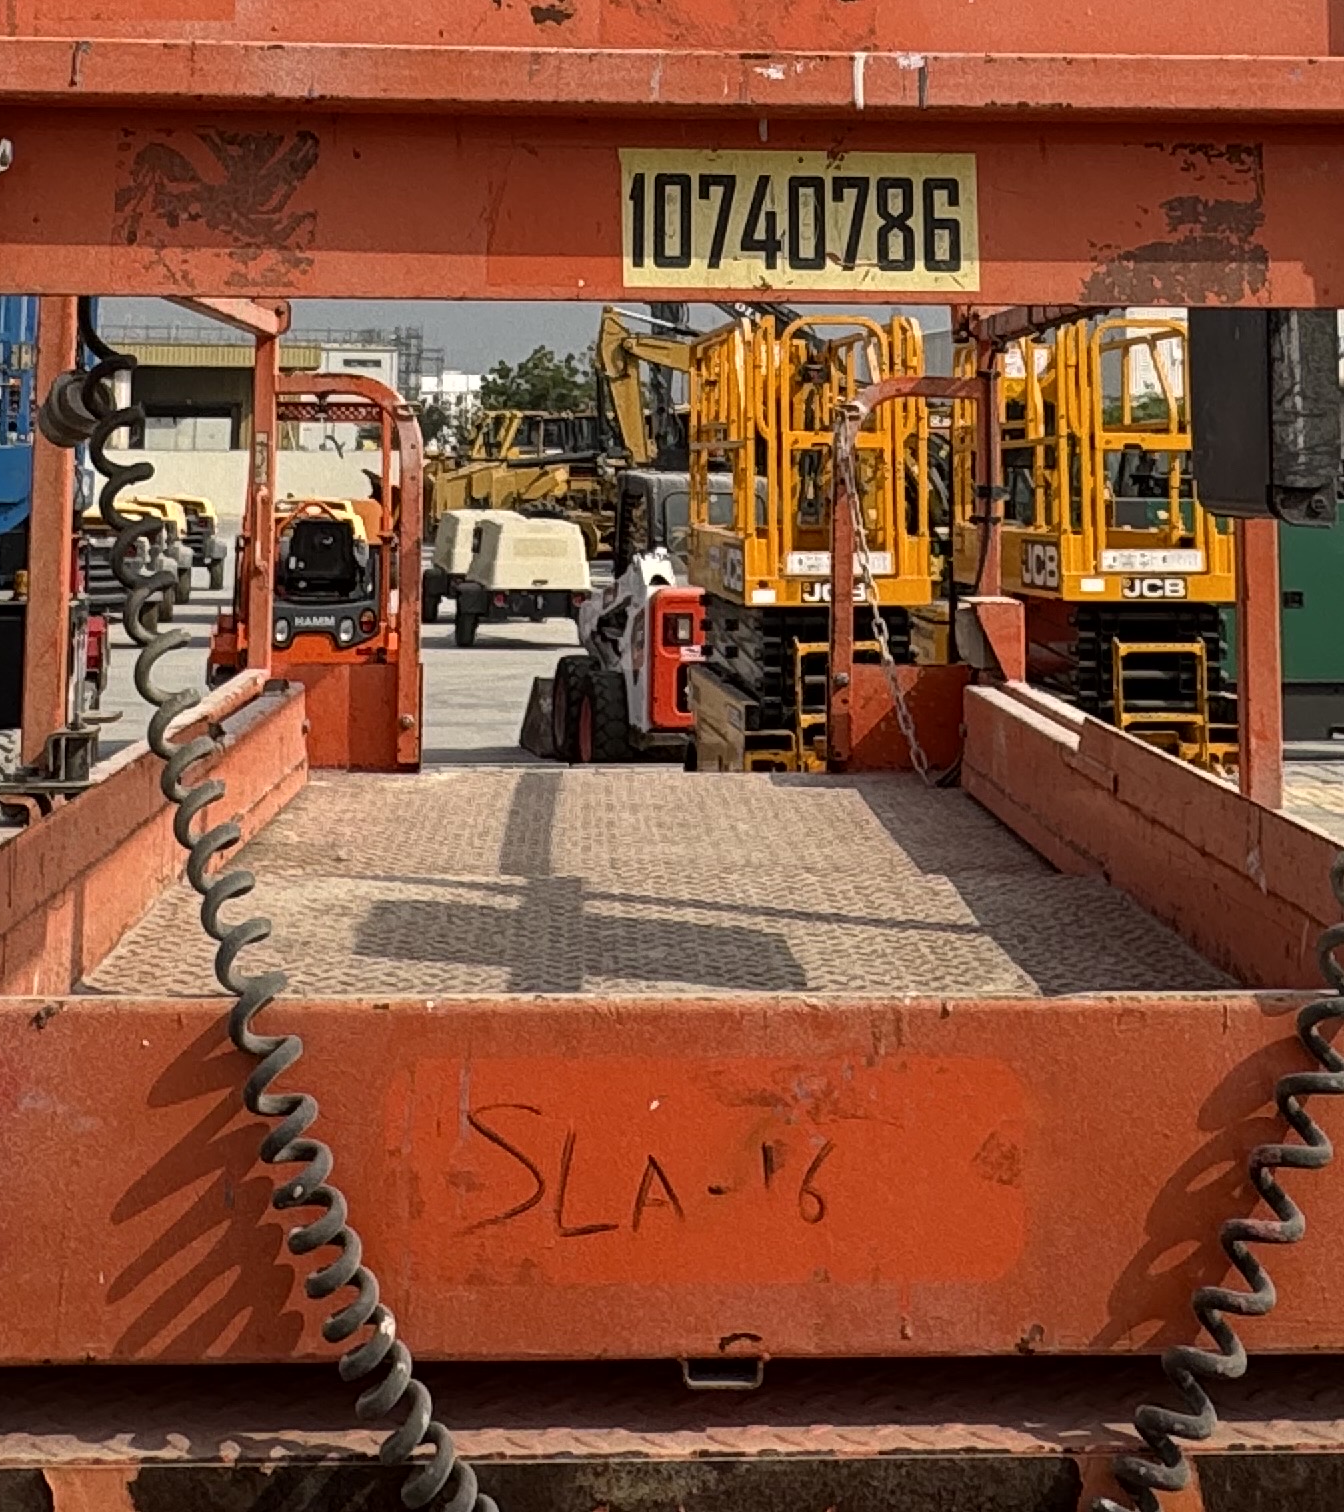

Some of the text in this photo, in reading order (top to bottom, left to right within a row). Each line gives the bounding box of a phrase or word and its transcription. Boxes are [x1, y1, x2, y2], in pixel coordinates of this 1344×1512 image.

[629, 172, 962, 272] 10740786
[1022, 543, 1058, 587] JCB
[1122, 578, 1187, 598] JCB
[294, 615, 336, 627] HAMM
